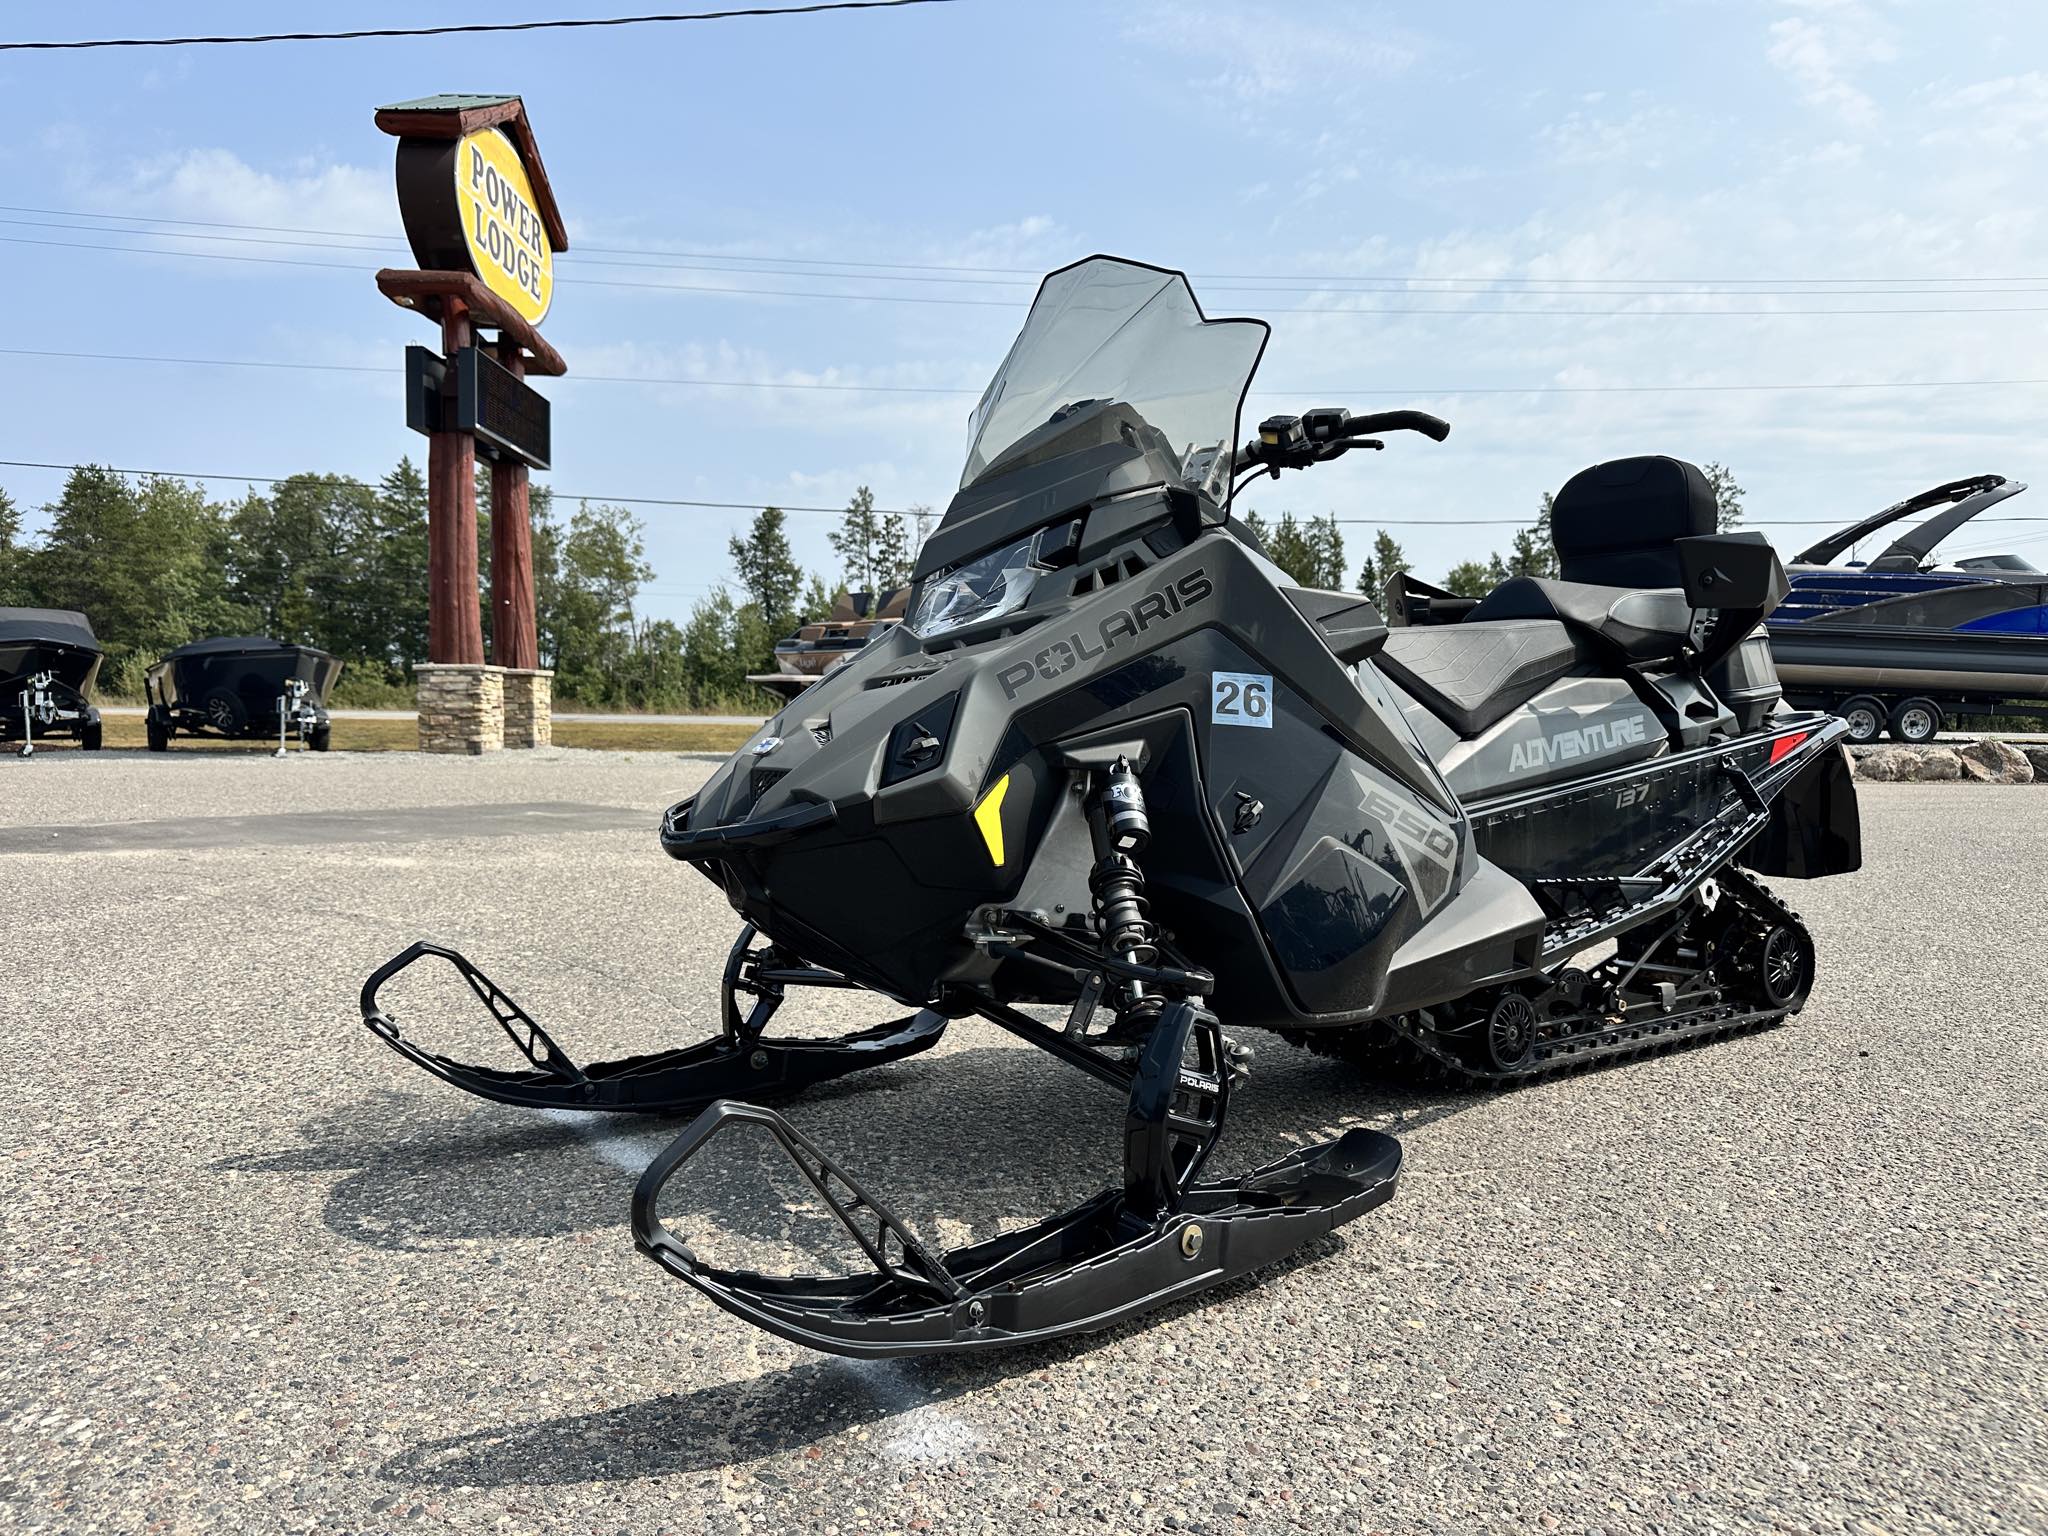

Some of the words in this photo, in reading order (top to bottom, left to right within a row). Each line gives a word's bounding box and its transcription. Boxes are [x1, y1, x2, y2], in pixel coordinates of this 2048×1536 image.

[471, 145, 543, 258] POWER
[475, 202, 541, 300] LODGE
[996, 567, 1214, 701] POLARIS
[1215, 681, 1267, 718] 26
[1508, 714, 1646, 773] ADVENTURE
[1358, 790, 1455, 860] 650
[1616, 784, 1650, 810] 137
[1180, 1075, 1220, 1093] POLARIS
